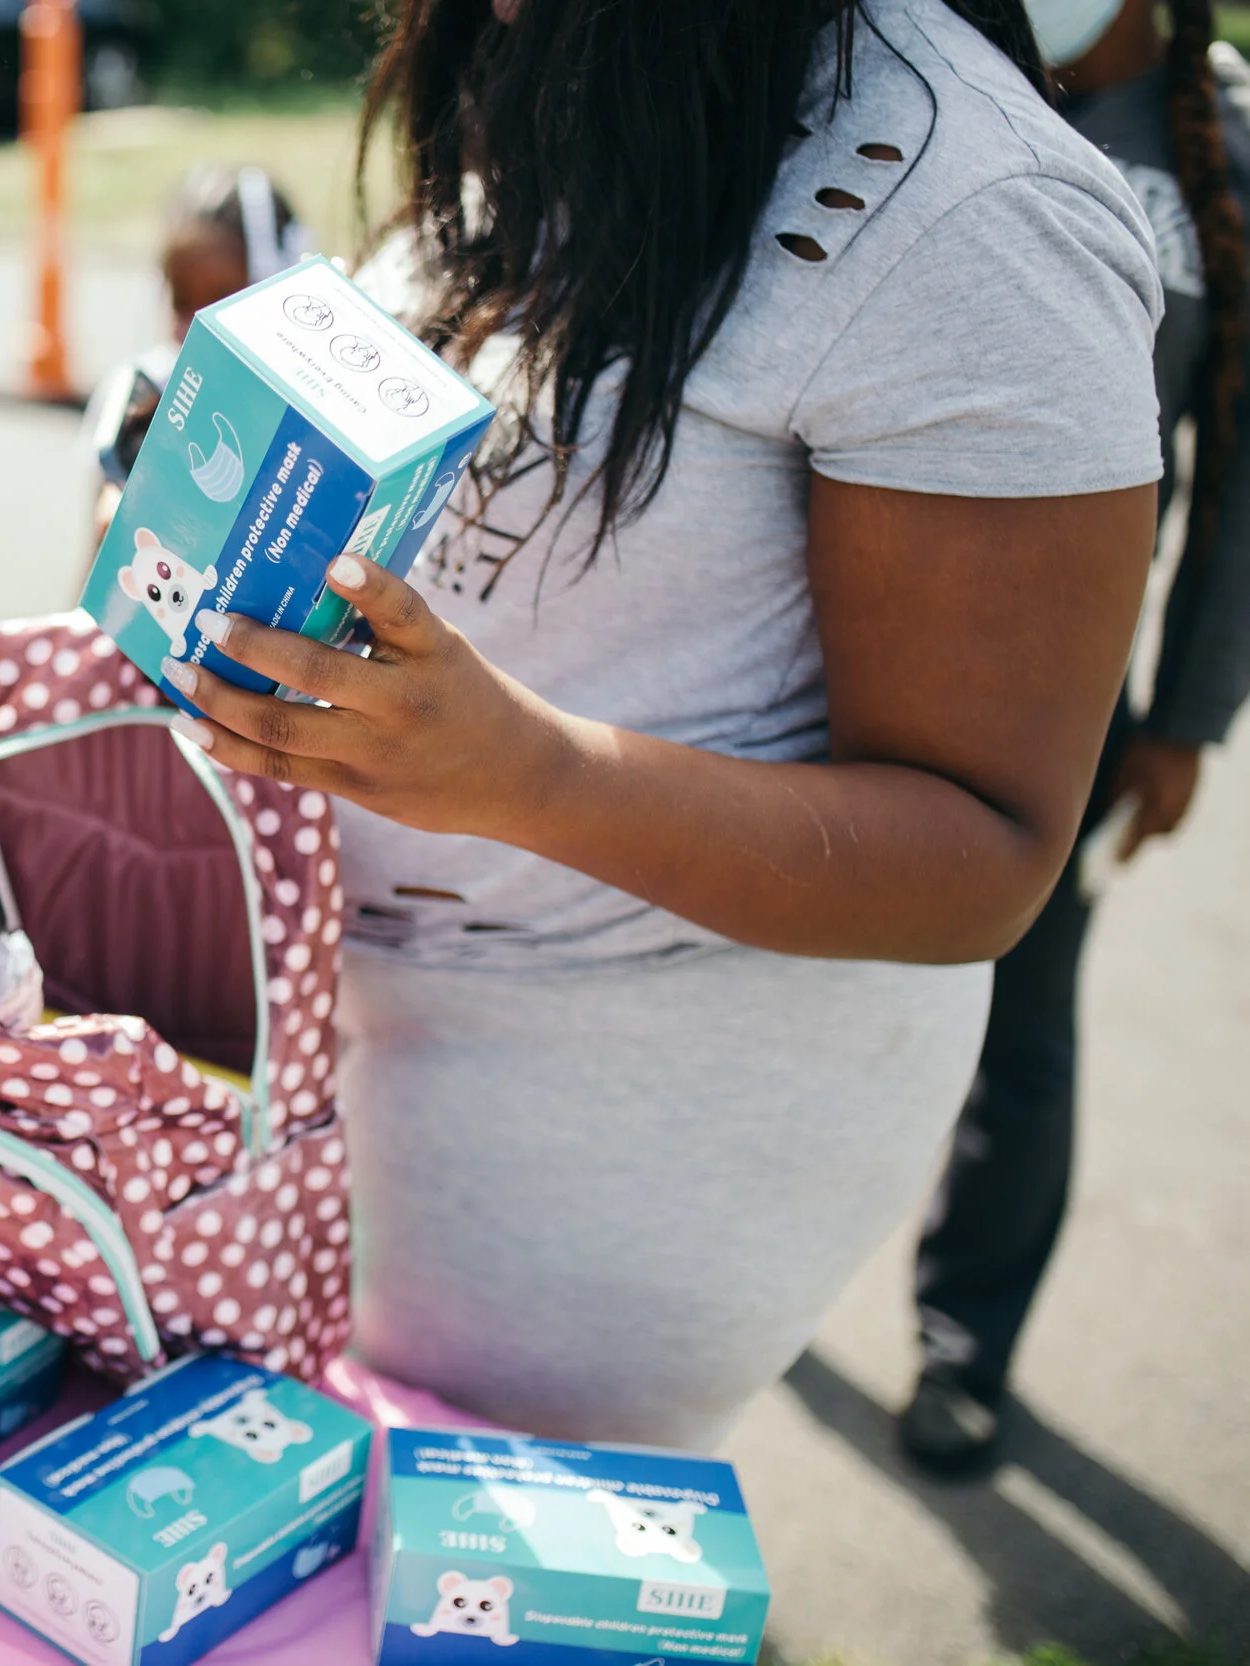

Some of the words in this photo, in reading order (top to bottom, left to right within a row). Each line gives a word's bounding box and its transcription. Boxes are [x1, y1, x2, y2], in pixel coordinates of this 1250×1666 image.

[167, 366, 203, 431] SIHE
[215, 558, 247, 614] children
[241, 482, 282, 562] protective
[276, 441, 302, 484] mask
[264, 528, 292, 564] (Non
[286, 458, 324, 529] medical)
[269, 612, 282, 628] ADE
[277, 605, 285, 614] IN
[281, 586, 295, 607] CHINA
